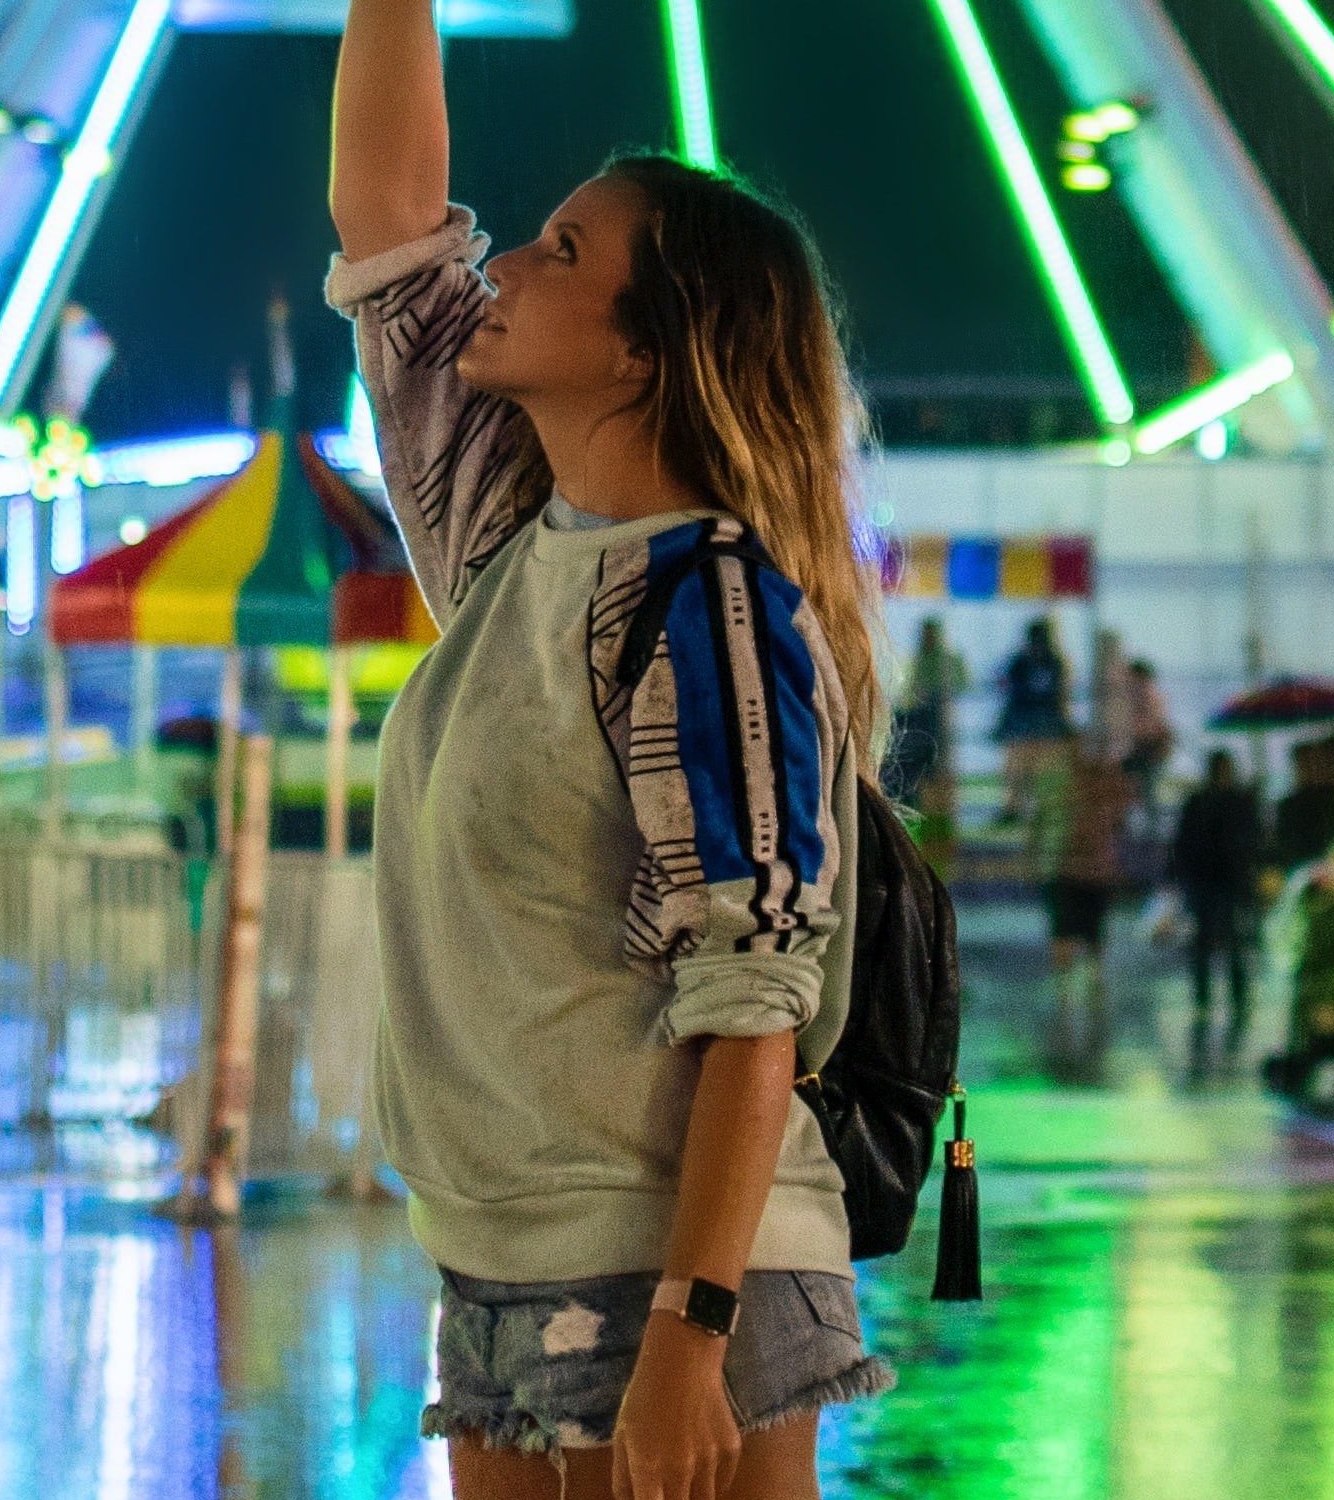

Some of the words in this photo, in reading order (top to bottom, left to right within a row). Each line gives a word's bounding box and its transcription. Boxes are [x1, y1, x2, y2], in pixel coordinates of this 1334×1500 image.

[729, 587, 745, 625] PINK
[746, 699, 761, 740] PINK
[758, 812, 771, 853] PINK
